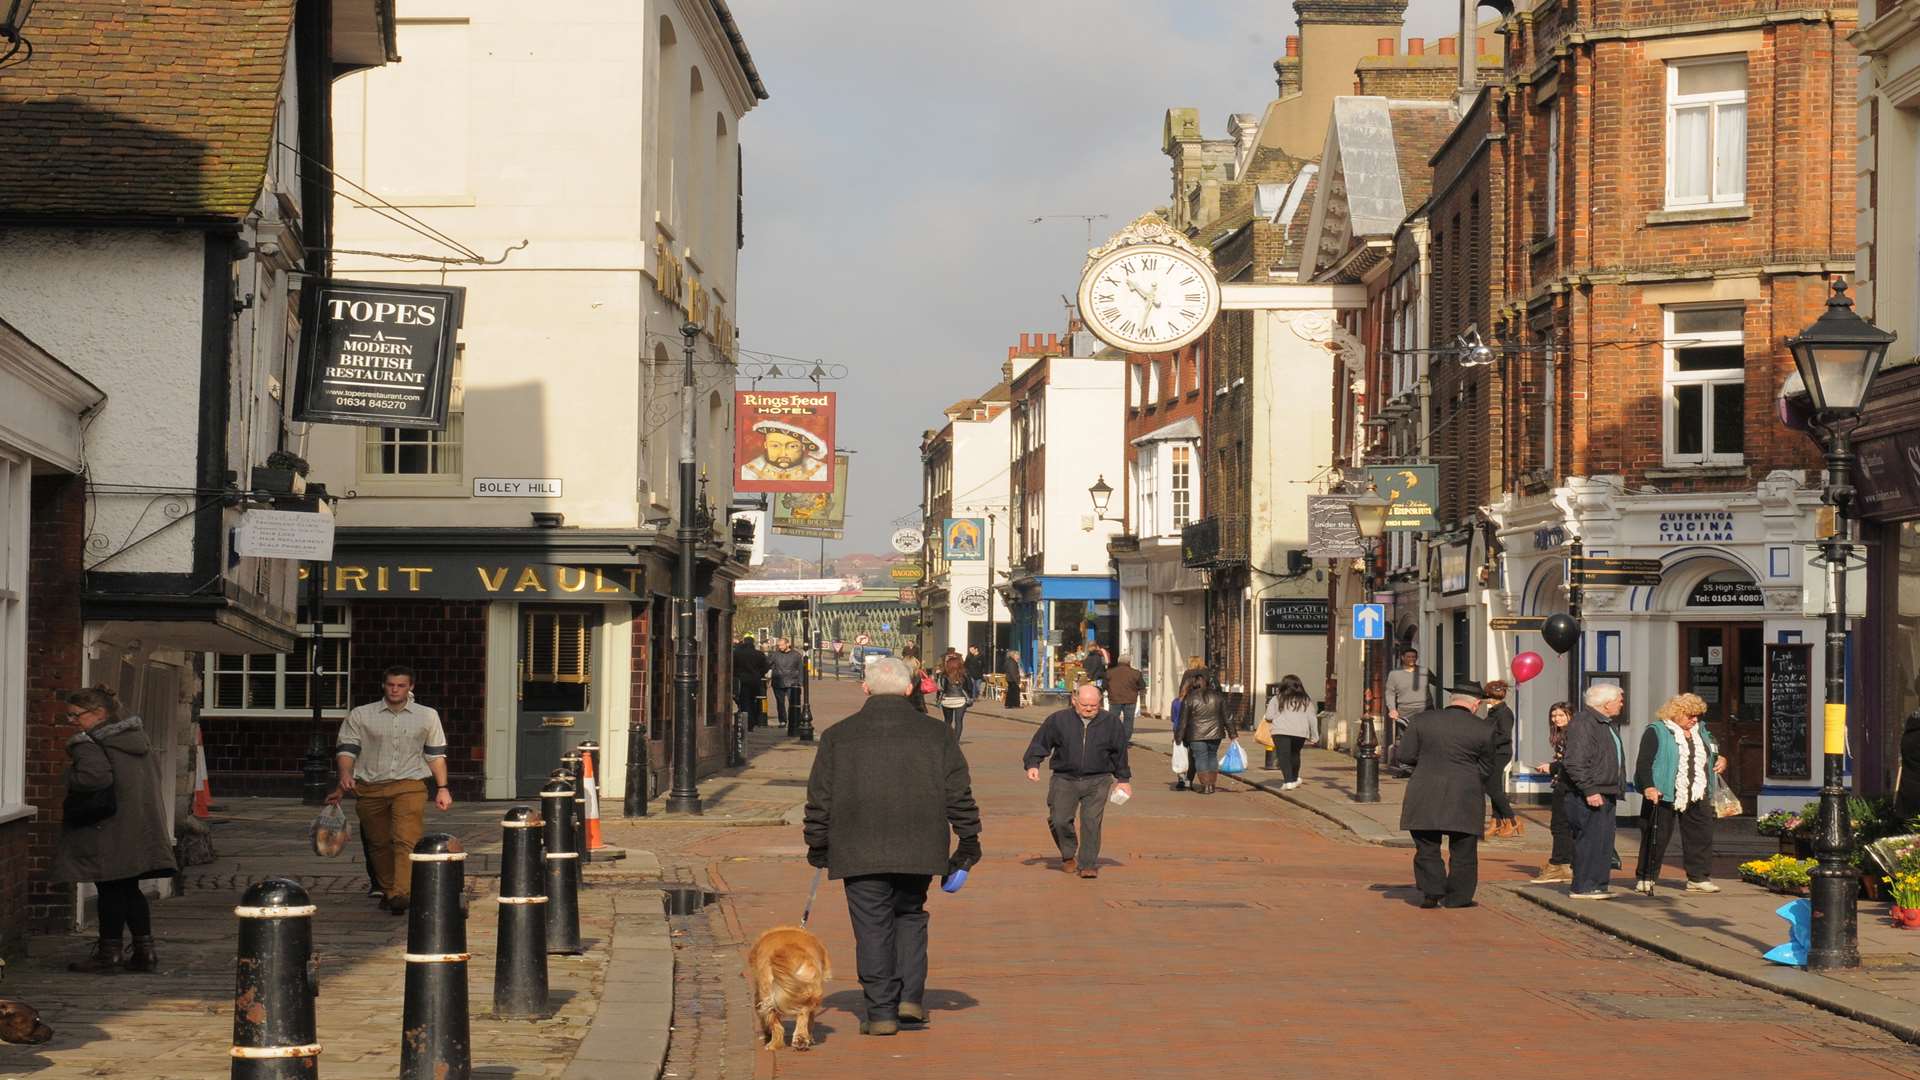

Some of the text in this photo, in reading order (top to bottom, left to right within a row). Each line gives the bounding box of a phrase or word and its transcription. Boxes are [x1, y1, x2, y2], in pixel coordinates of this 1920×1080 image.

[328, 299, 435, 326] TOPES
[373, 331, 385, 341] A
[344, 341, 413, 355] MODERN
[340, 354, 413, 370] BRITISH
[325, 367, 425, 383] RESTAURANT
[326, 389, 420, 401] www.topesrestaurant.com
[336, 397, 407, 410] 01634 845270
[758, 407, 813, 415] HOTEL
[479, 483, 556, 493] BOLEY HILL
[1660, 512, 1734, 521] AUTENTICA
[1660, 521, 1733, 531] CUCINA
[1660, 532, 1733, 541] ITALIANA
[477, 566, 642, 592] VAULT
[1715, 584, 1734, 592] High
